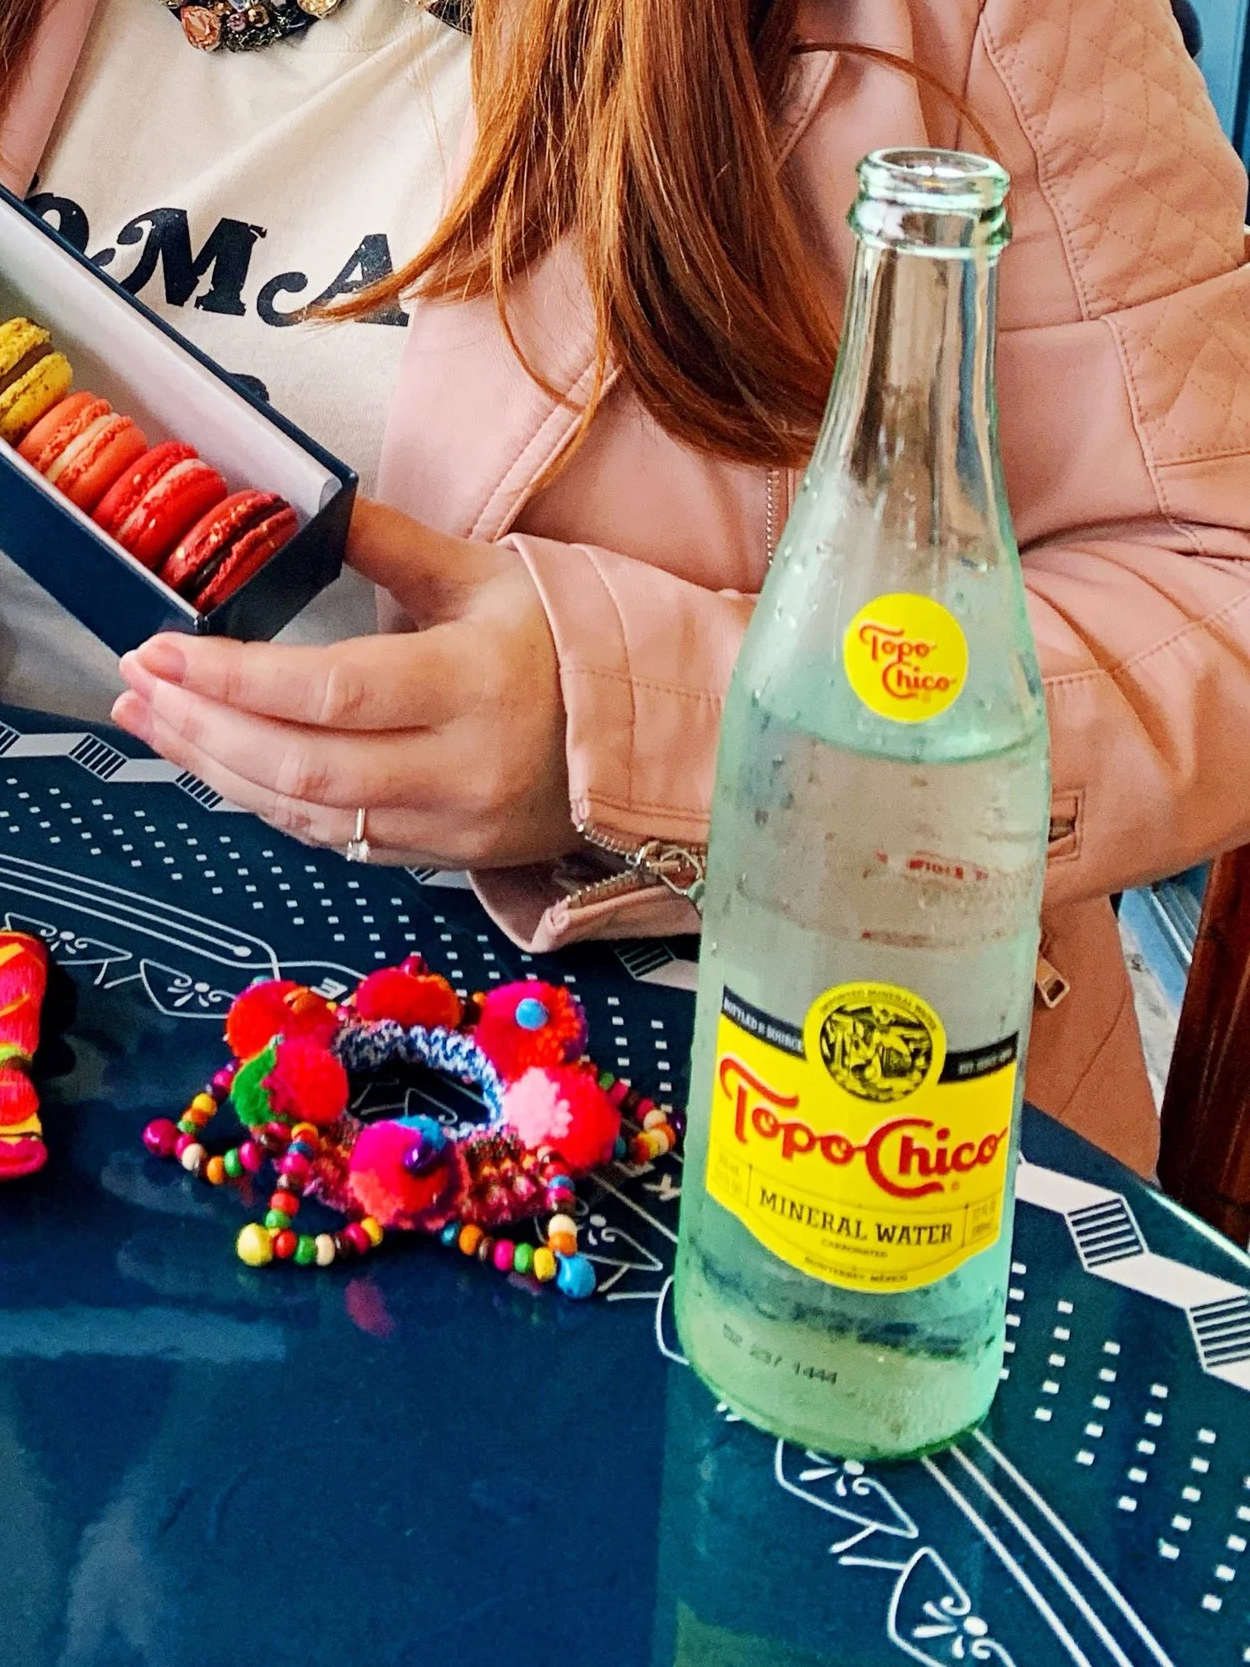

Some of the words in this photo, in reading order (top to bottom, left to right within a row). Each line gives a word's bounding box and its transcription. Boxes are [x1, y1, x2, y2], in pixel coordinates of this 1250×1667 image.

[859, 623, 938, 662] Topo
[881, 660, 957, 700] Chico
[719, 1055, 857, 1165] Topo
[863, 1118, 1008, 1199] Chico
[759, 1185, 869, 1241] MINERAL
[875, 1221, 953, 1247] WATER
